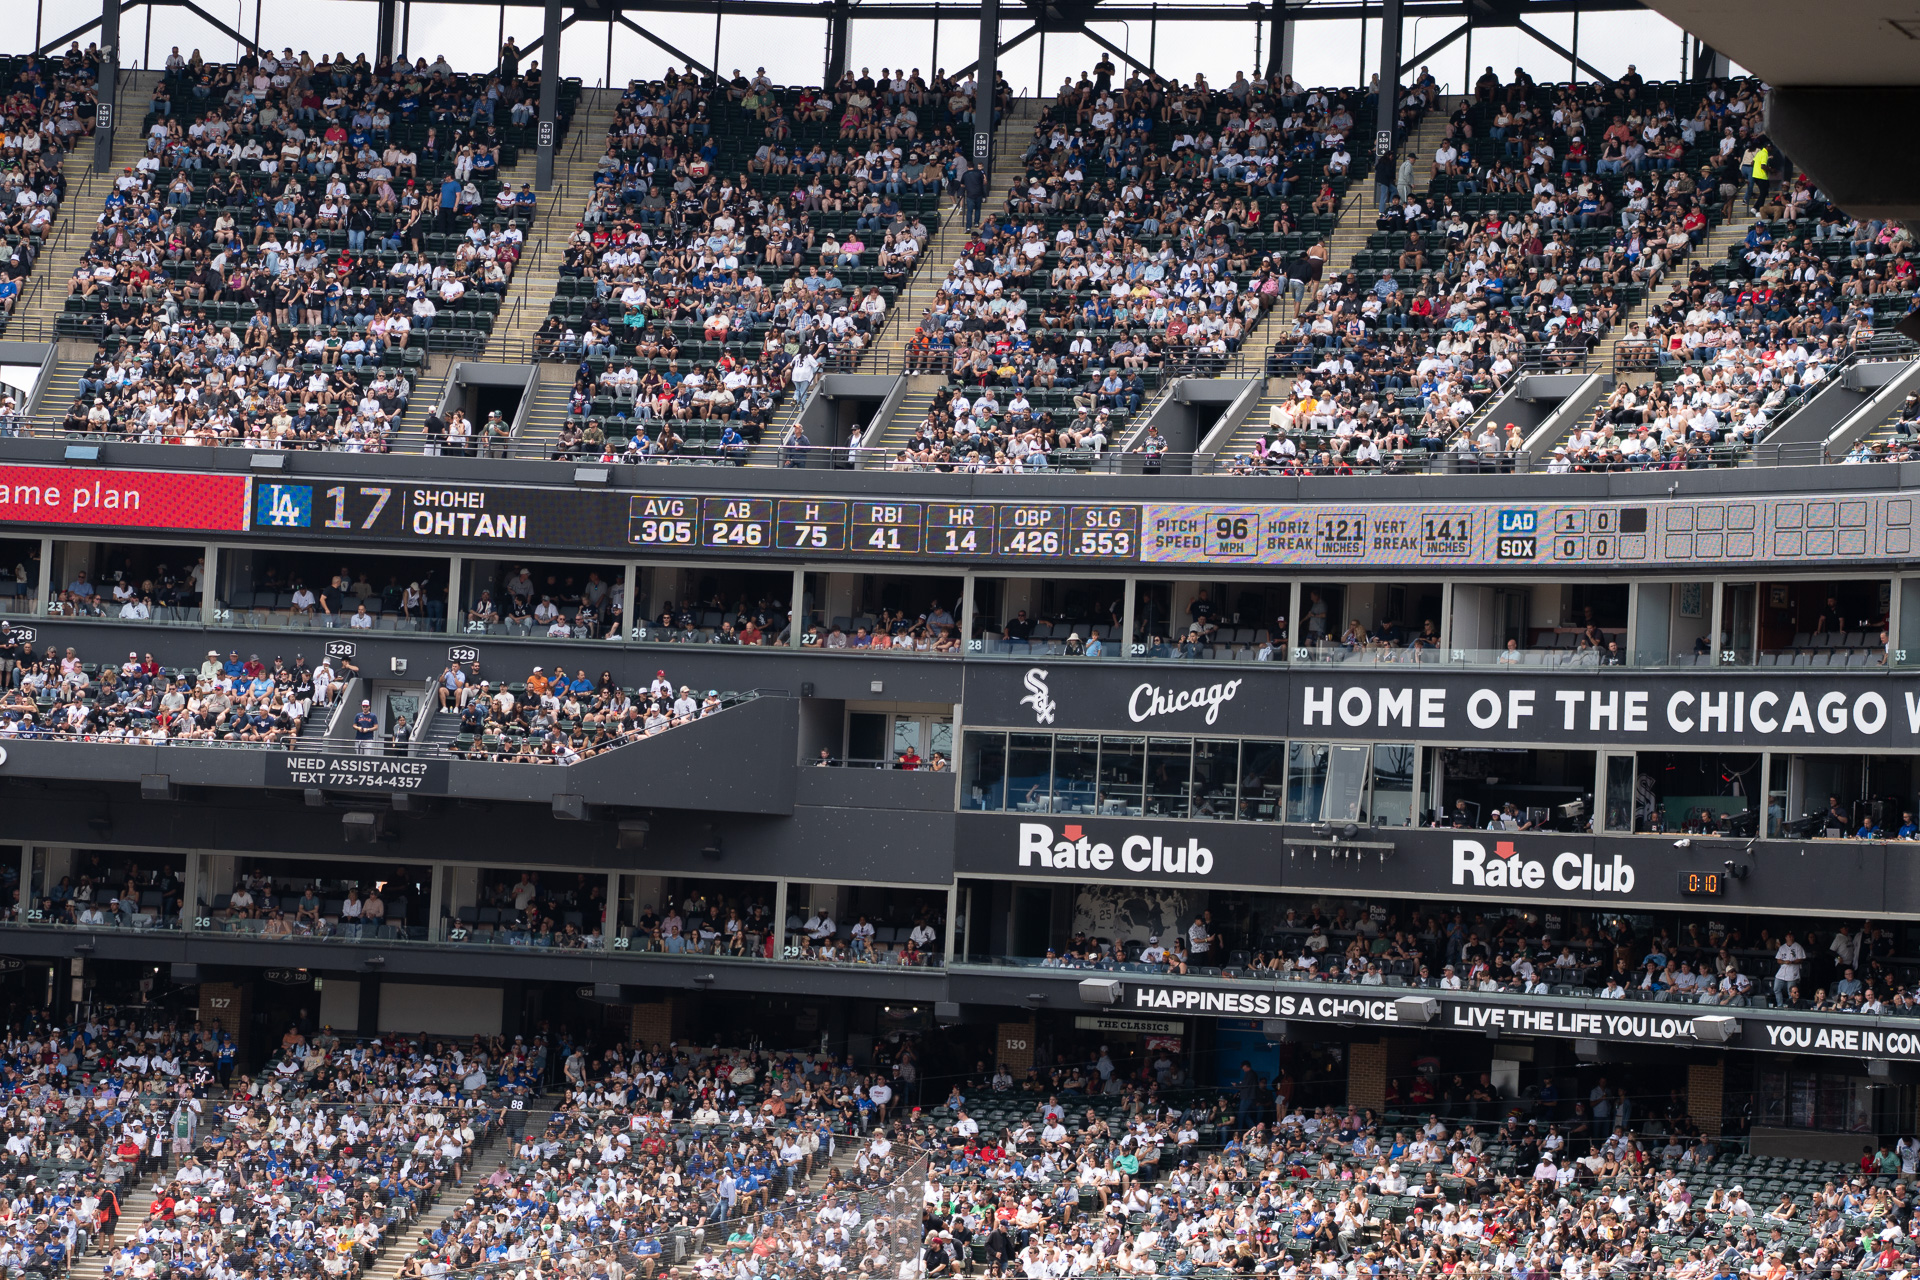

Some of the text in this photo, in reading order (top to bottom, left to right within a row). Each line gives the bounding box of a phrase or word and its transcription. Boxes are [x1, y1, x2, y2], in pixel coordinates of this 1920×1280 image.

[73, 481, 140, 513] plan
[413, 490, 485, 509] SHOHEI
[269, 484, 300, 527] LA
[325, 486, 392, 529] 17
[644, 500, 685, 517] AVG
[724, 502, 751, 519] AB
[805, 504, 819, 521] H
[871, 506, 903, 523] RBI
[949, 508, 974, 525] HR
[1014, 509, 1051, 526] OBP
[1085, 510, 1121, 527] SLG
[413, 511, 527, 539] OHTANI
[1156, 519, 1198, 533] PITCH
[1216, 518, 1249, 540] 96
[1268, 521, 1310, 535] HORIZ
[1374, 521, 1406, 534] VERT
[1502, 513, 1608, 531] LAD 1 0
[634, 520, 691, 543] .305
[712, 523, 762, 545] 246
[795, 525, 828, 547] 75
[1318, 520, 1364, 542] -12.1
[1425, 520, 1468, 542] 14.1
[868, 528, 901, 549] 41
[945, 530, 977, 552] 14
[1004, 531, 1059, 553] .426
[1074, 532, 1130, 555] .553
[1155, 535, 1202, 549] SPEED
[1267, 537, 1314, 551] BREAK
[1373, 537, 1418, 551] BREAK
[1219, 542, 1245, 554] MPH
[1322, 542, 1360, 554] INCHES
[1427, 541, 1466, 554] INCHES
[1501, 540, 1607, 557] SOX 0 0
[48, 601, 63, 612] 23
[214, 609, 230, 620] 24
[469, 620, 485, 631] 25
[631, 627, 647, 639] 26
[801, 634, 817, 645] 27
[329, 644, 352, 655] 328
[968, 640, 983, 651] 28
[1131, 644, 1146, 655] 29
[452, 649, 475, 660] 329
[1294, 648, 1308, 659] 30
[1453, 650, 1465, 661] 31
[1722, 651, 1736, 662] 32
[1895, 650, 1907, 661] 33
[1128, 678, 1242, 725] Chicago
[1303, 686, 1447, 728] HOME
[1467, 688, 1536, 729] OF
[1555, 690, 1649, 732] THE
[1666, 690, 1887, 735] CHICAGO
[287, 757, 428, 775] NEED ASSISTANCE?
[290, 771, 423, 789] TEXT 773-754-4357
[1019, 822, 1214, 875] Rate Club
[1452, 839, 1635, 894] Rate Club
[1688, 873, 1717, 893] 0:10
[27, 909, 43, 920] 25
[1099, 909, 1112, 921] 25
[1369, 904, 1387, 914] Rate
[195, 916, 211, 928] 26
[1369, 913, 1387, 921] Club
[1545, 913, 1562, 922] Rate
[1545, 921, 1561, 929] Club
[1708, 920, 1725, 930] Rate
[451, 929, 467, 940] 27
[614, 937, 629, 948] 28
[784, 945, 799, 957] 29
[8, 960, 20, 968] 127
[267, 971, 280, 979] 127
[294, 973, 307, 981] 128
[581, 989, 593, 997] 128
[210, 998, 231, 1009] 127
[1137, 988, 1399, 1022] HAPPINESS IS A CHOICE
[1097, 1020, 1170, 1032] THE CLASSICS
[1454, 1006, 1504, 1028] LIVE
[1508, 1010, 1554, 1031] THE
[1557, 1012, 1602, 1034] LIFE
[1605, 1014, 1647, 1037] YOU
[1006, 1039, 1027, 1050] 130
[1766, 1025, 1812, 1047] YOU
[1814, 1028, 1859, 1051] ARE
[1862, 1031, 1883, 1052] IN
[195, 1072, 206, 1085] 54
[511, 1099, 524, 1110] 88
